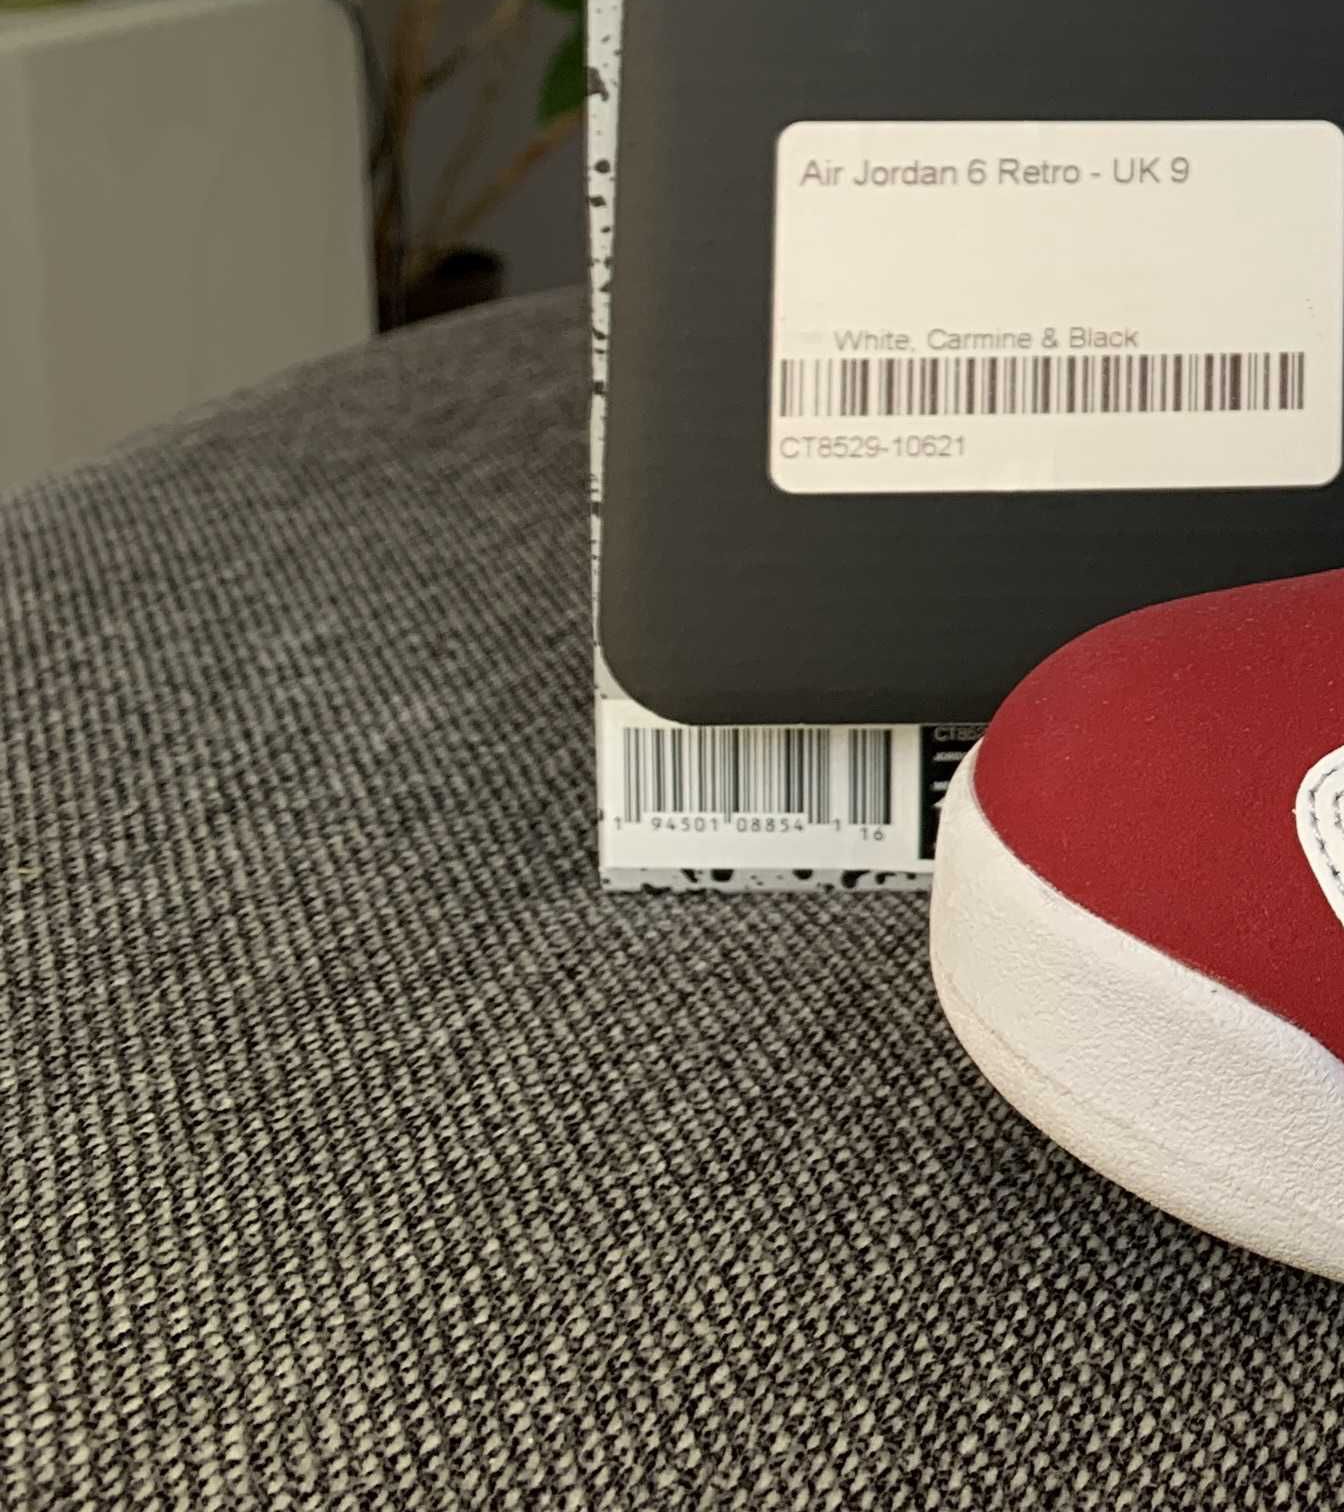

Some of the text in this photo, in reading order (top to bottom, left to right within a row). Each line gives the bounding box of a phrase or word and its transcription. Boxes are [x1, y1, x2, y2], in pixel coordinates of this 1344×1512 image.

[799, 159, 844, 187] Air
[853, 159, 958, 187] Jordan
[967, 158, 987, 186] 6
[999, 157, 1081, 186] Retro
[1113, 156, 1161, 185] UK
[1170, 156, 1190, 184] 9
[833, 325, 1139, 353] White, Carmine & Black
[779, 434, 966, 462] CT8529-10621
[614, 816, 842, 833] 1 94501 08854 1
[860, 828, 886, 842] 16
